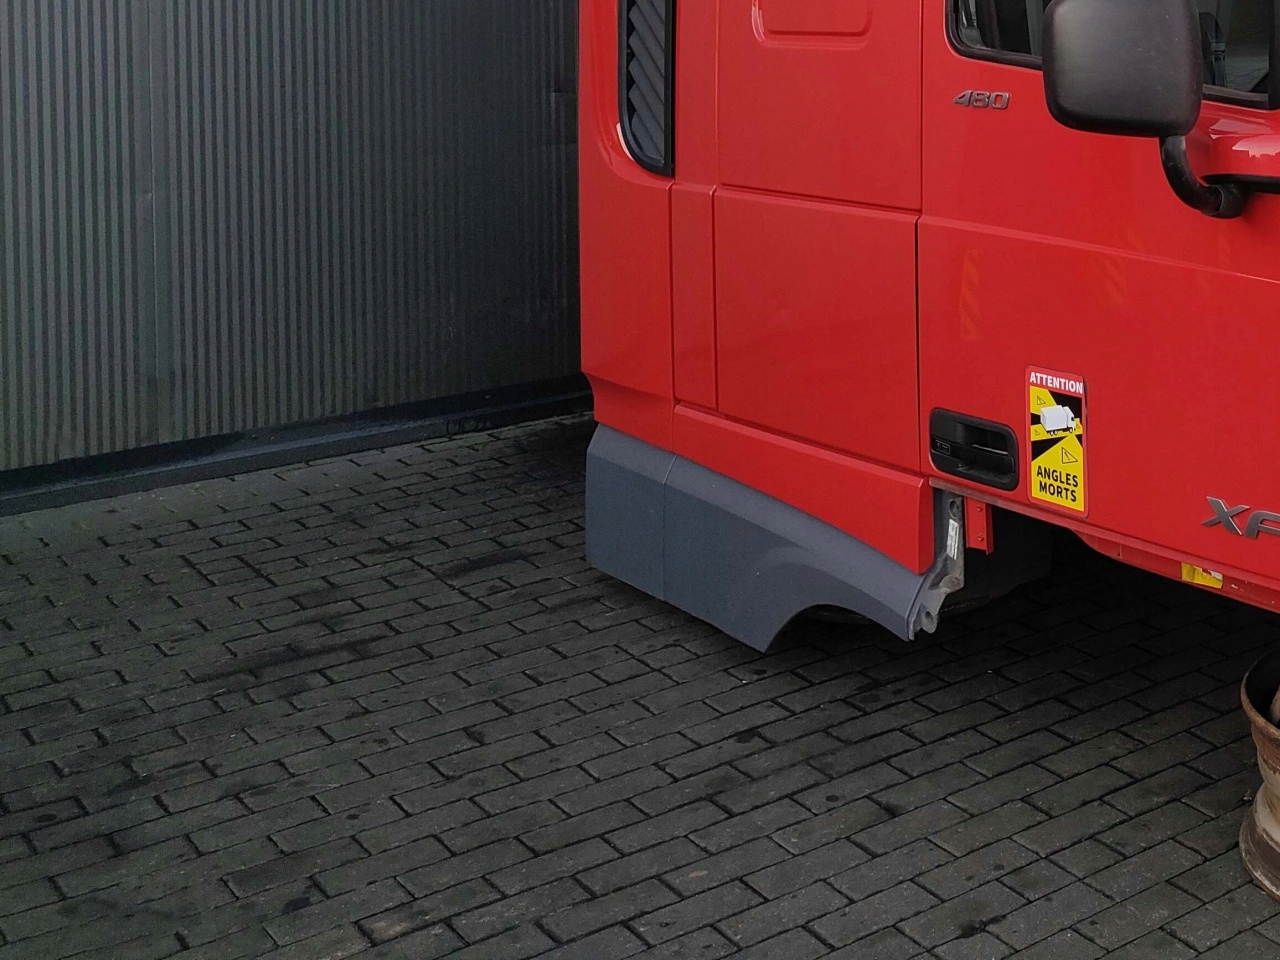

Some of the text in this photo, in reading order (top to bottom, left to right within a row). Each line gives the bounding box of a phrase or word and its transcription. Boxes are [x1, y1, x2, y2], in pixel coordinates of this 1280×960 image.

[953, 90, 1011, 110] 480
[1029, 371, 1083, 394] ATTENTION
[1036, 465, 1078, 488] ANGLES
[1039, 480, 1077, 503] MORTS
